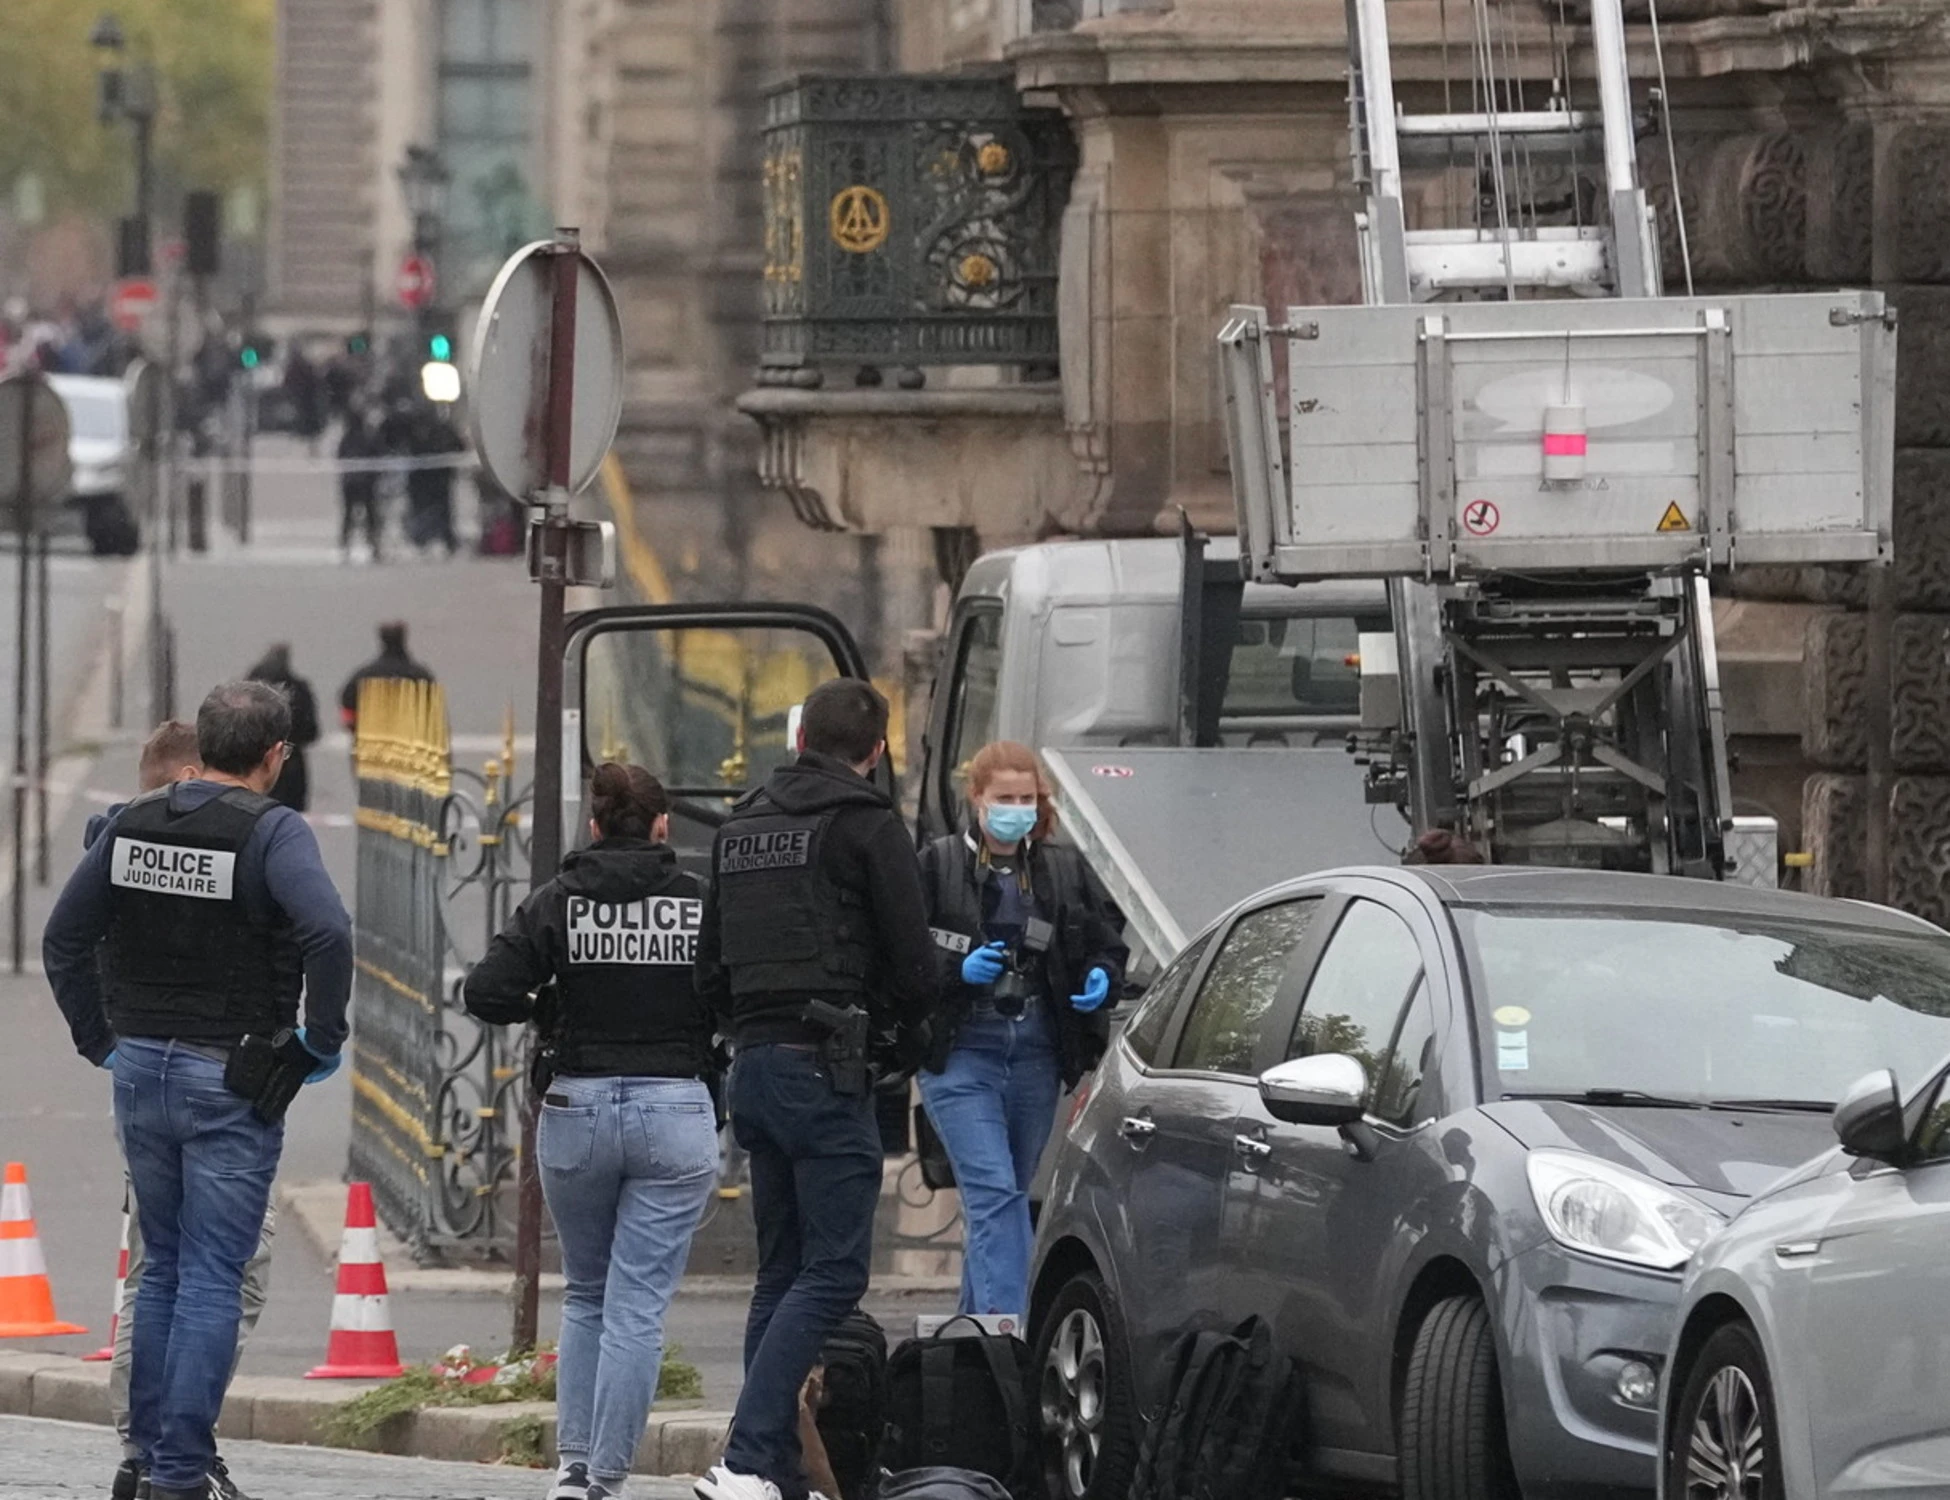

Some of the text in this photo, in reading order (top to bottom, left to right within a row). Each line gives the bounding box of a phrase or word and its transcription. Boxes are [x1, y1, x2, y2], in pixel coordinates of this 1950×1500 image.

[724, 832, 806, 858] POLICE
[129, 845, 213, 876] POLICE
[123, 869, 217, 893] JUDICIAIRE
[570, 899, 700, 930] POLICE
